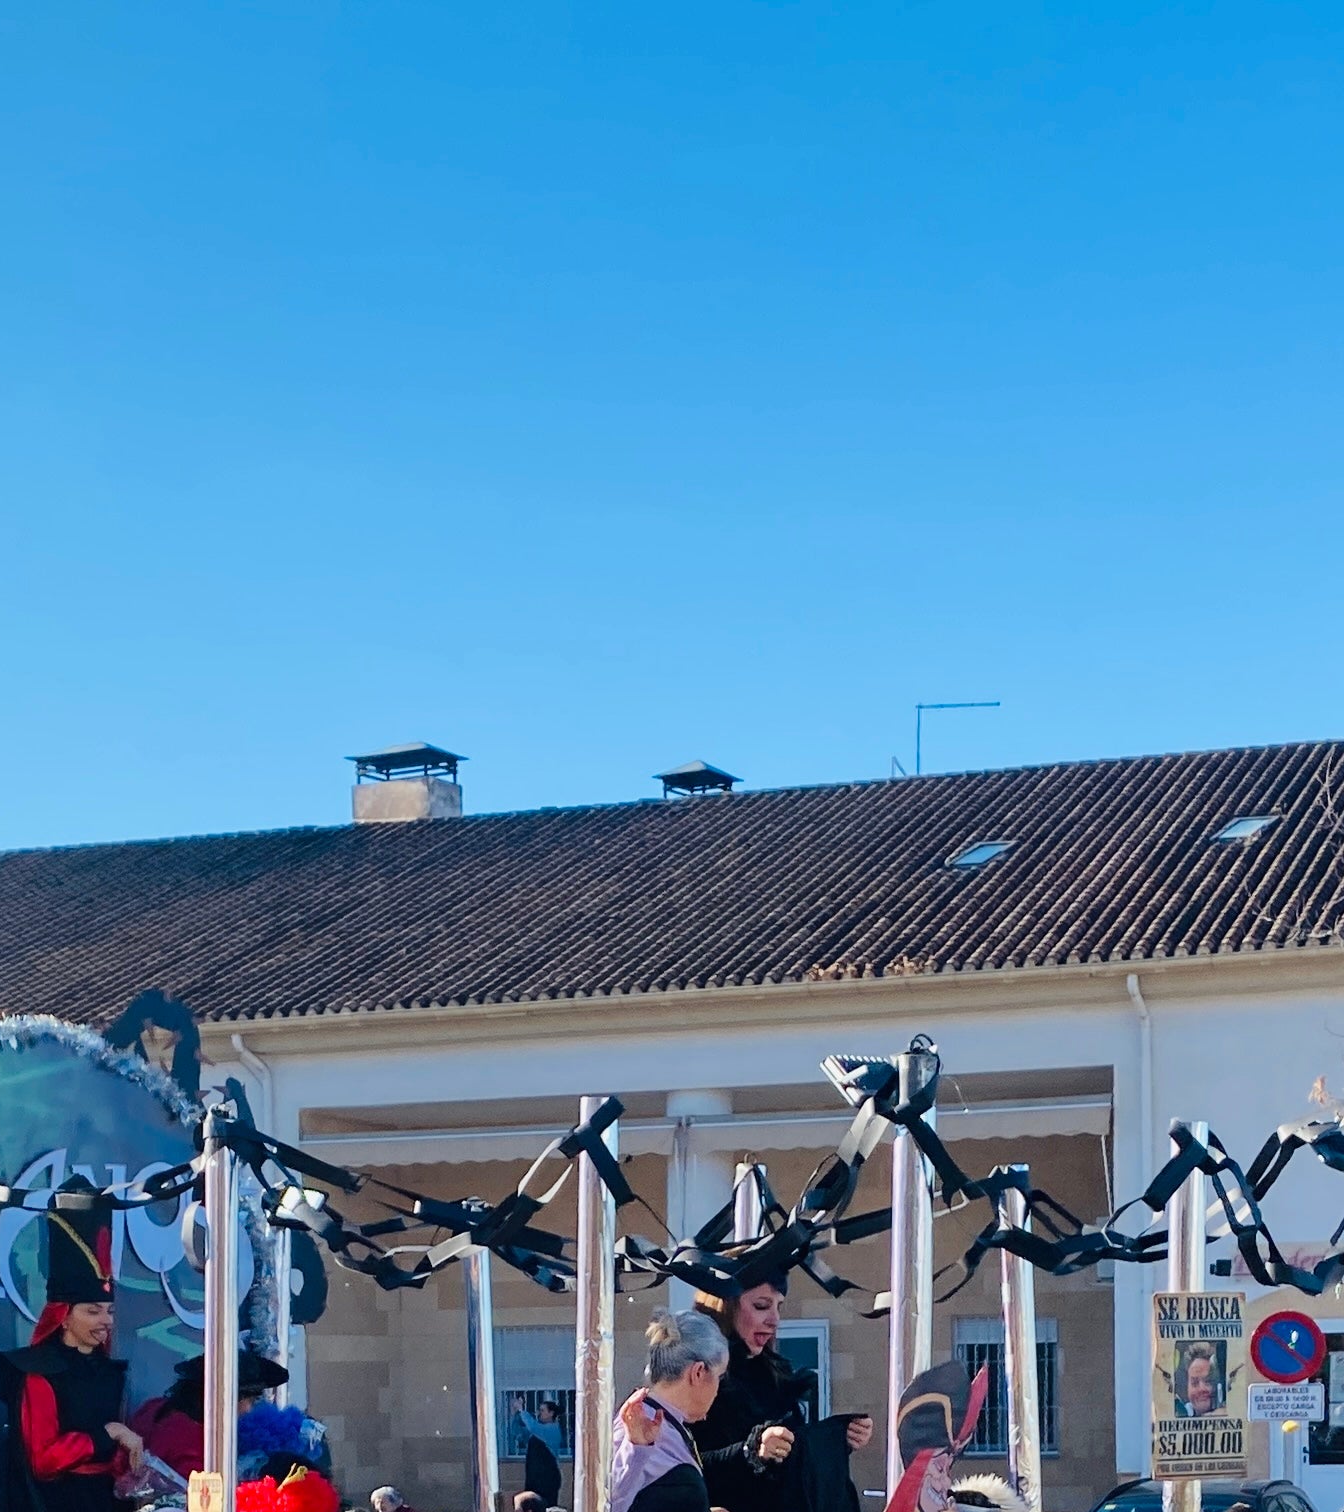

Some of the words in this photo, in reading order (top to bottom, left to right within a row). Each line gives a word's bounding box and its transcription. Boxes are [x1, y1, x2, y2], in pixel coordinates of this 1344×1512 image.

[1158, 1297, 1179, 1320] SE
[1186, 1296, 1241, 1320] BUSCA
[1159, 1324, 1184, 1338] VIVO
[1188, 1324, 1195, 1338] O
[1199, 1323, 1242, 1338] MUERTO
[1159, 1419, 1242, 1432] RECOMPENSA
[1159, 1432, 1242, 1457] $5,000.00
